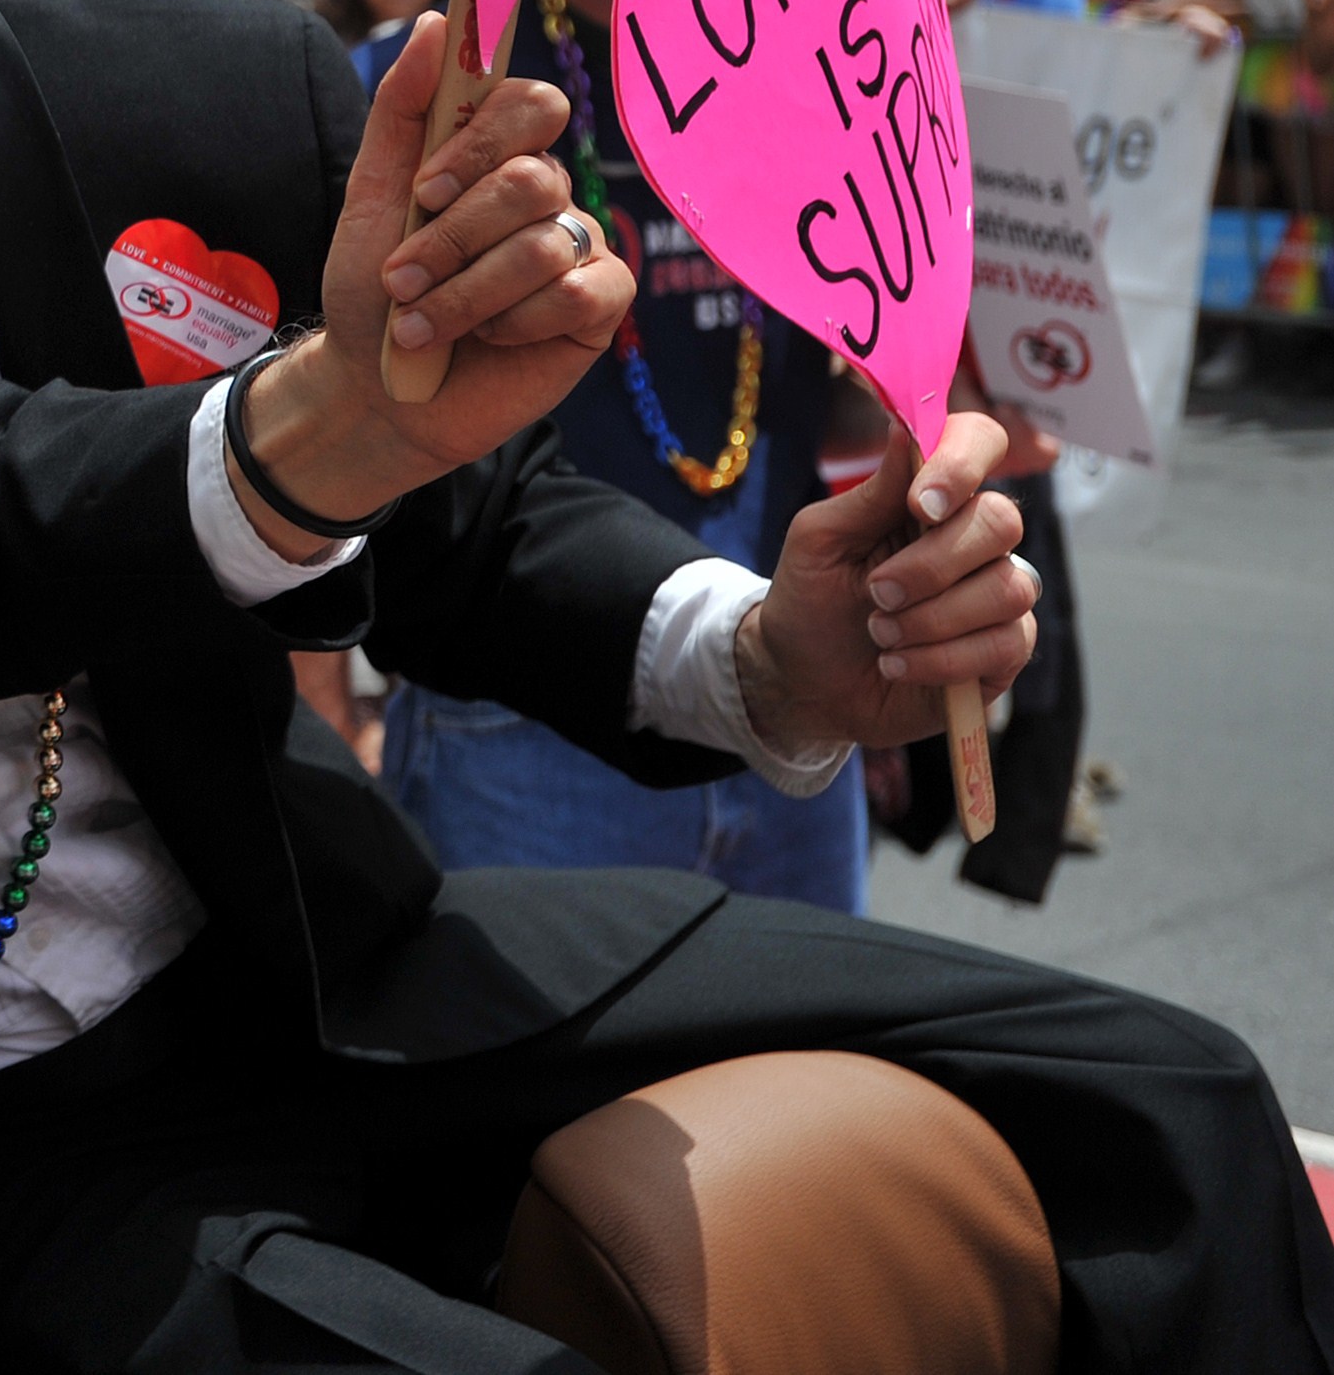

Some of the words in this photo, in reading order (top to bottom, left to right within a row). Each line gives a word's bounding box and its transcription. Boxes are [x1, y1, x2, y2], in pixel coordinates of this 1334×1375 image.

[974, 209, 1094, 264] atrimonio
[121, 241, 146, 261] LOVE
[162, 260, 227, 299] COMMITMENT
[235, 297, 273, 323] FAMILY
[186, 331, 209, 350] usa
[192, 318, 239, 349] equality
